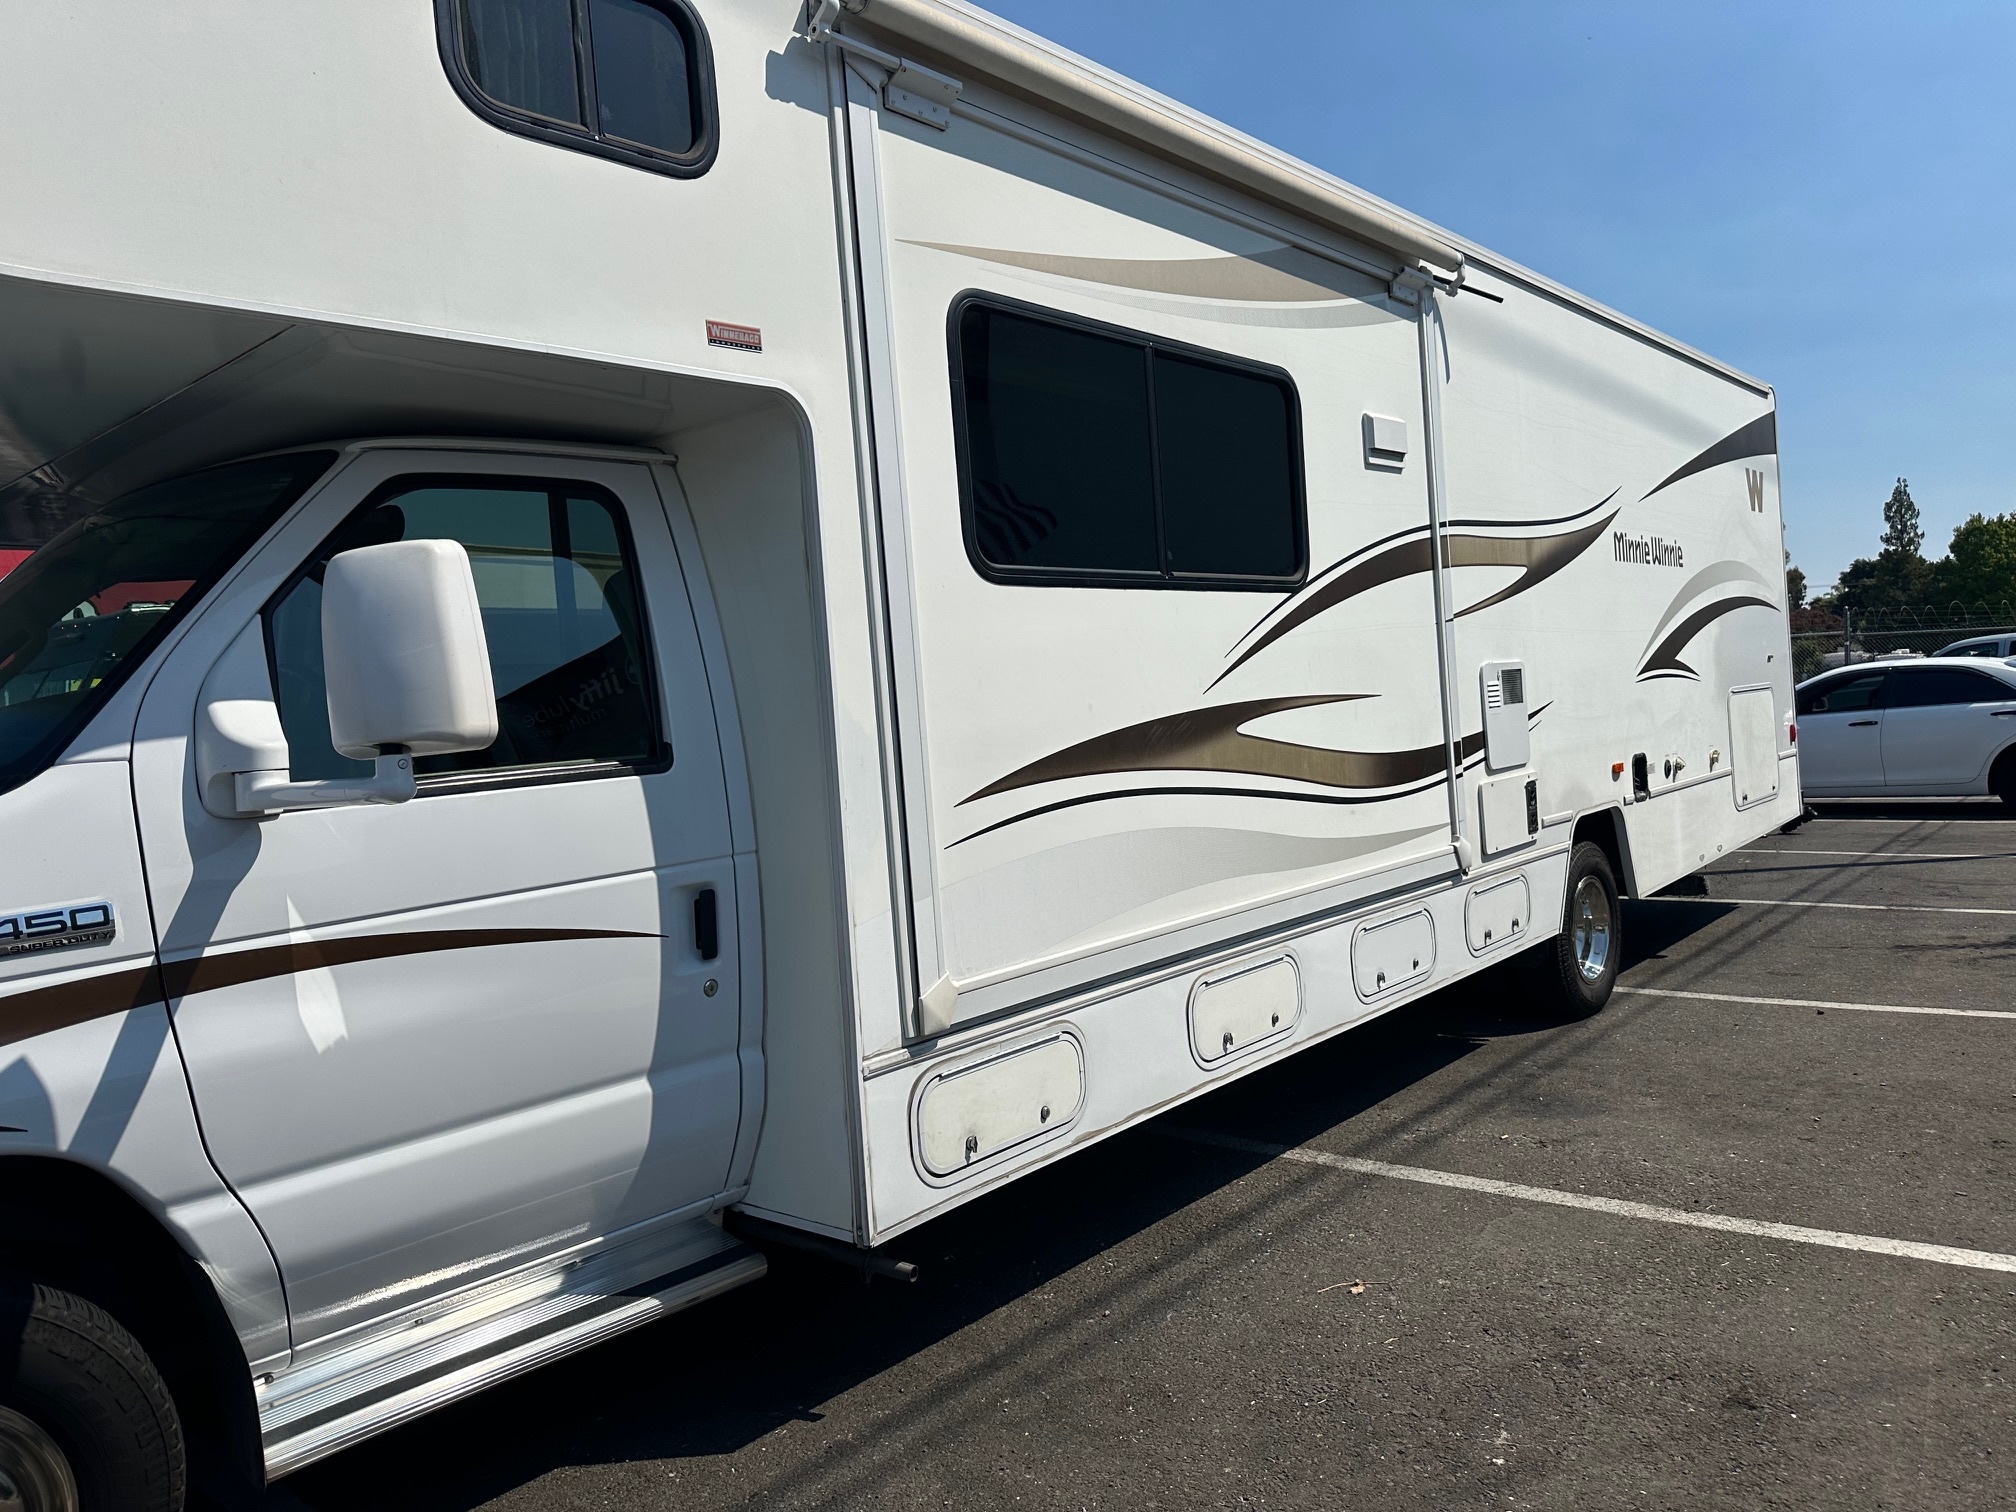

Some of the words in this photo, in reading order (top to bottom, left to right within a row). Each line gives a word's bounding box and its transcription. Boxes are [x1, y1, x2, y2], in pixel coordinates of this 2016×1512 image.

[707, 323, 760, 344] WINNEBAGO
[1744, 467, 1764, 513] W
[1613, 530, 1651, 564] Minnie
[1651, 536, 1684, 568] Winnie
[8, 935, 66, 955] SUPER
